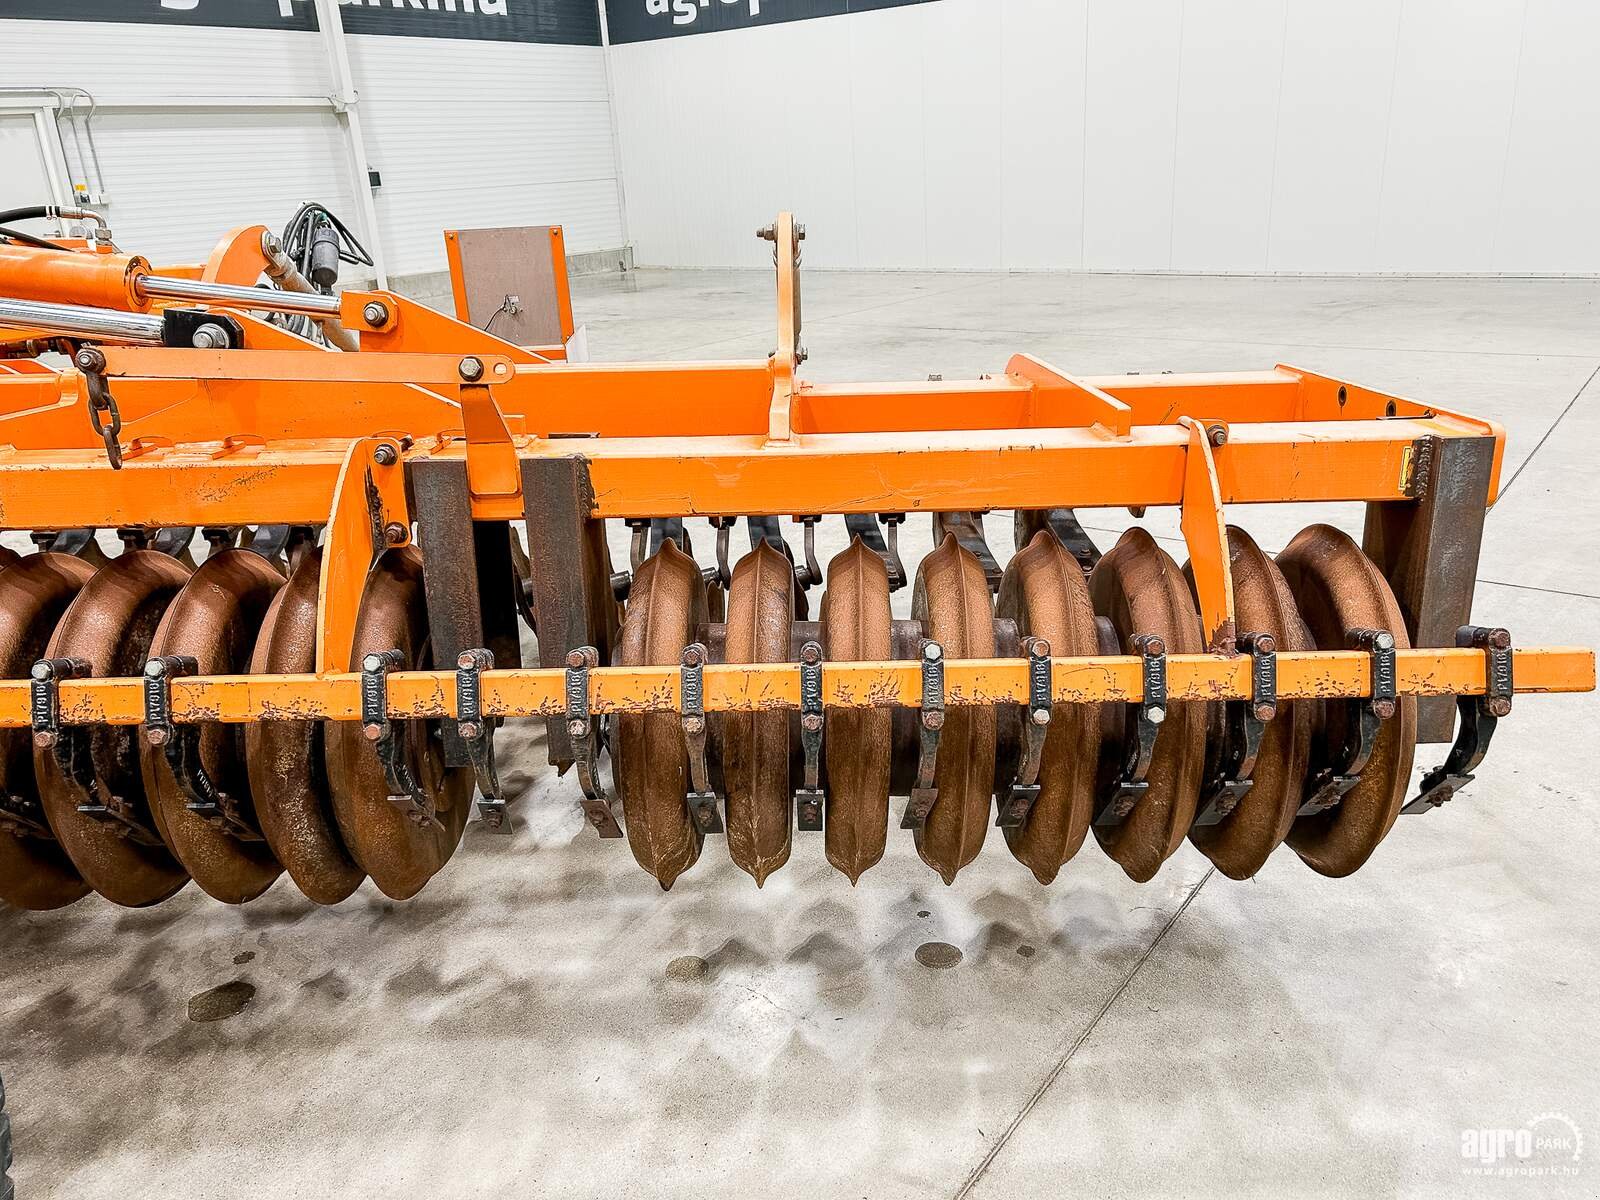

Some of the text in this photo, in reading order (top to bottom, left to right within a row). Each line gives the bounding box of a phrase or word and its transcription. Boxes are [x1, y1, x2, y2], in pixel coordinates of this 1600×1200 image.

[36, 685, 49, 723] P17916
[148, 681, 162, 720] P17916
[365, 676, 379, 716] P17916
